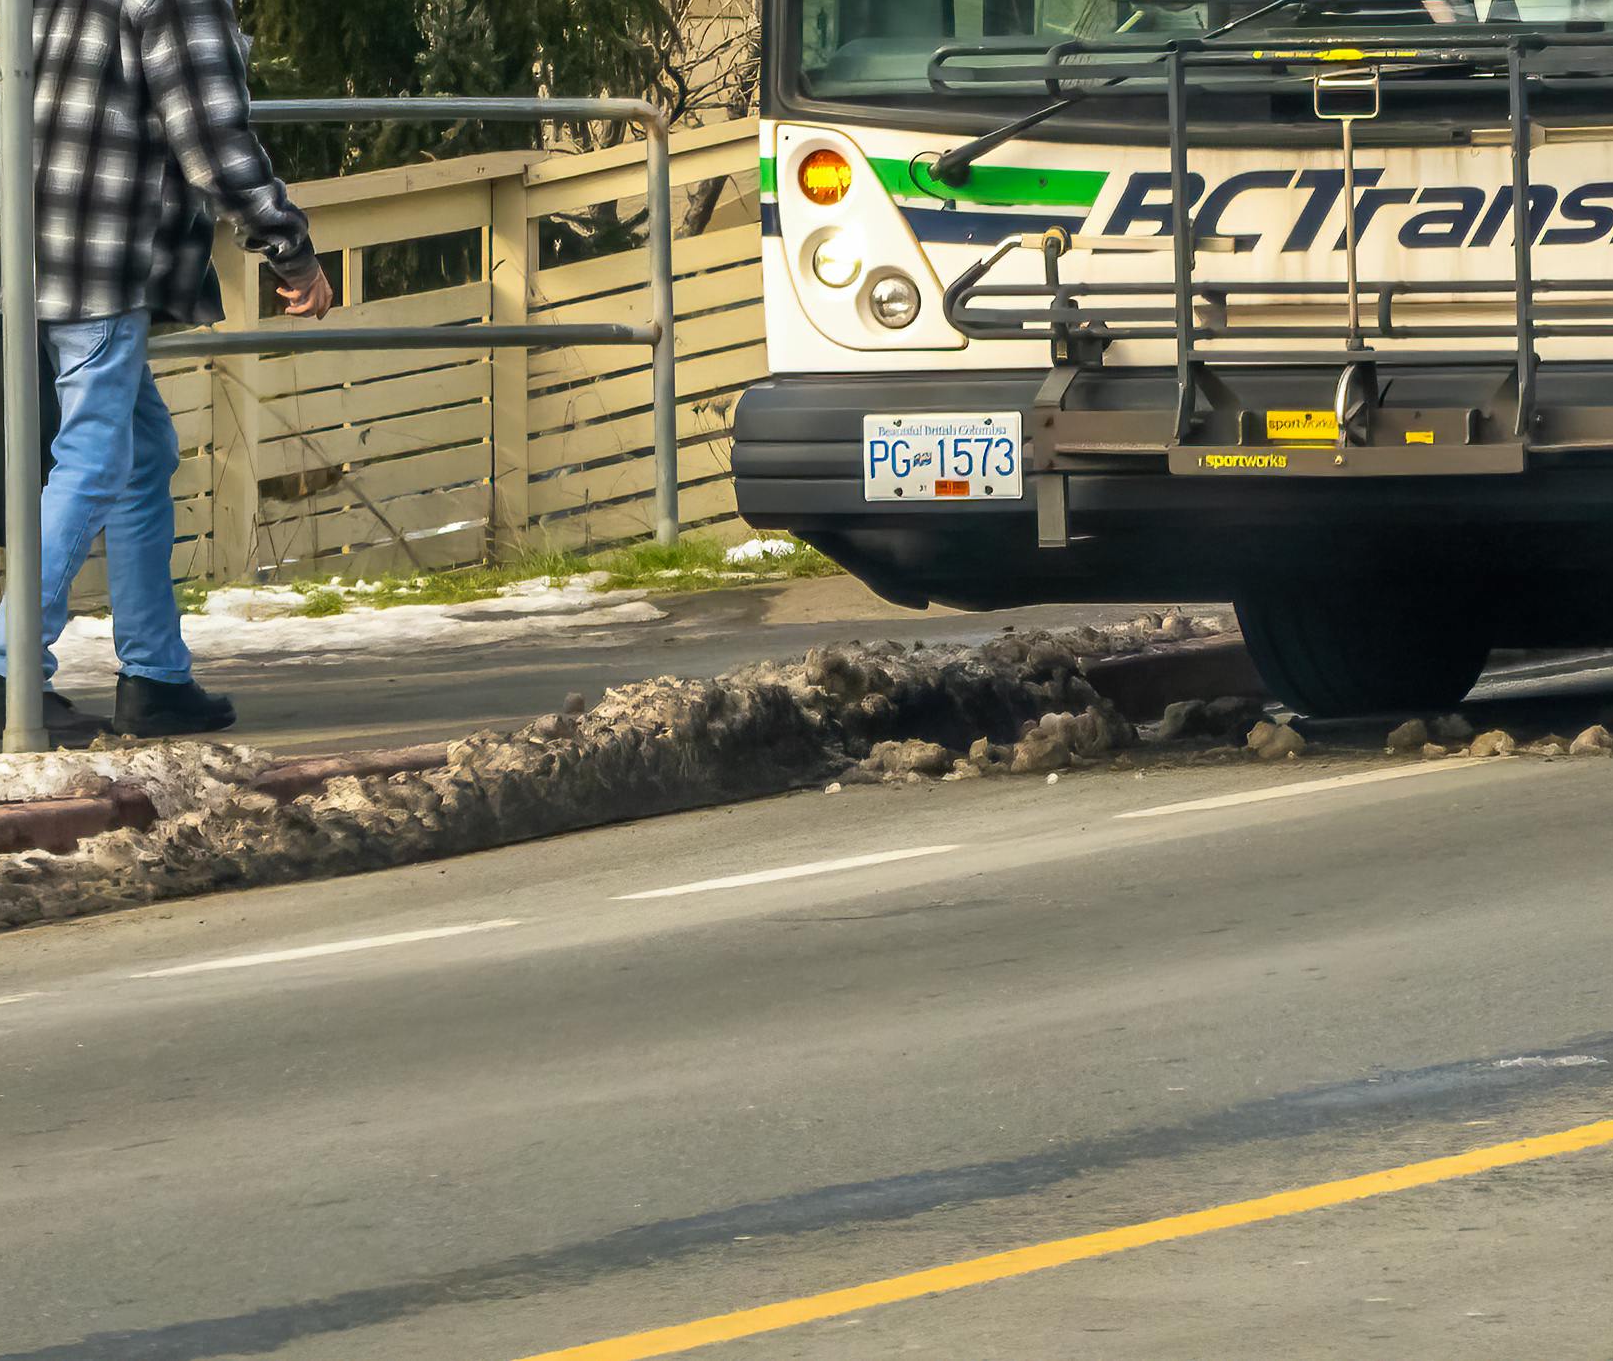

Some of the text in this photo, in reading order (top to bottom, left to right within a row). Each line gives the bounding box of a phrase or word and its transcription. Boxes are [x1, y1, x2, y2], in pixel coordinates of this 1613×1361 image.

[958, 424, 1007, 436] Columbia
[869, 437, 1016, 480] PG 1573
[1205, 453, 1288, 470] sportworks
